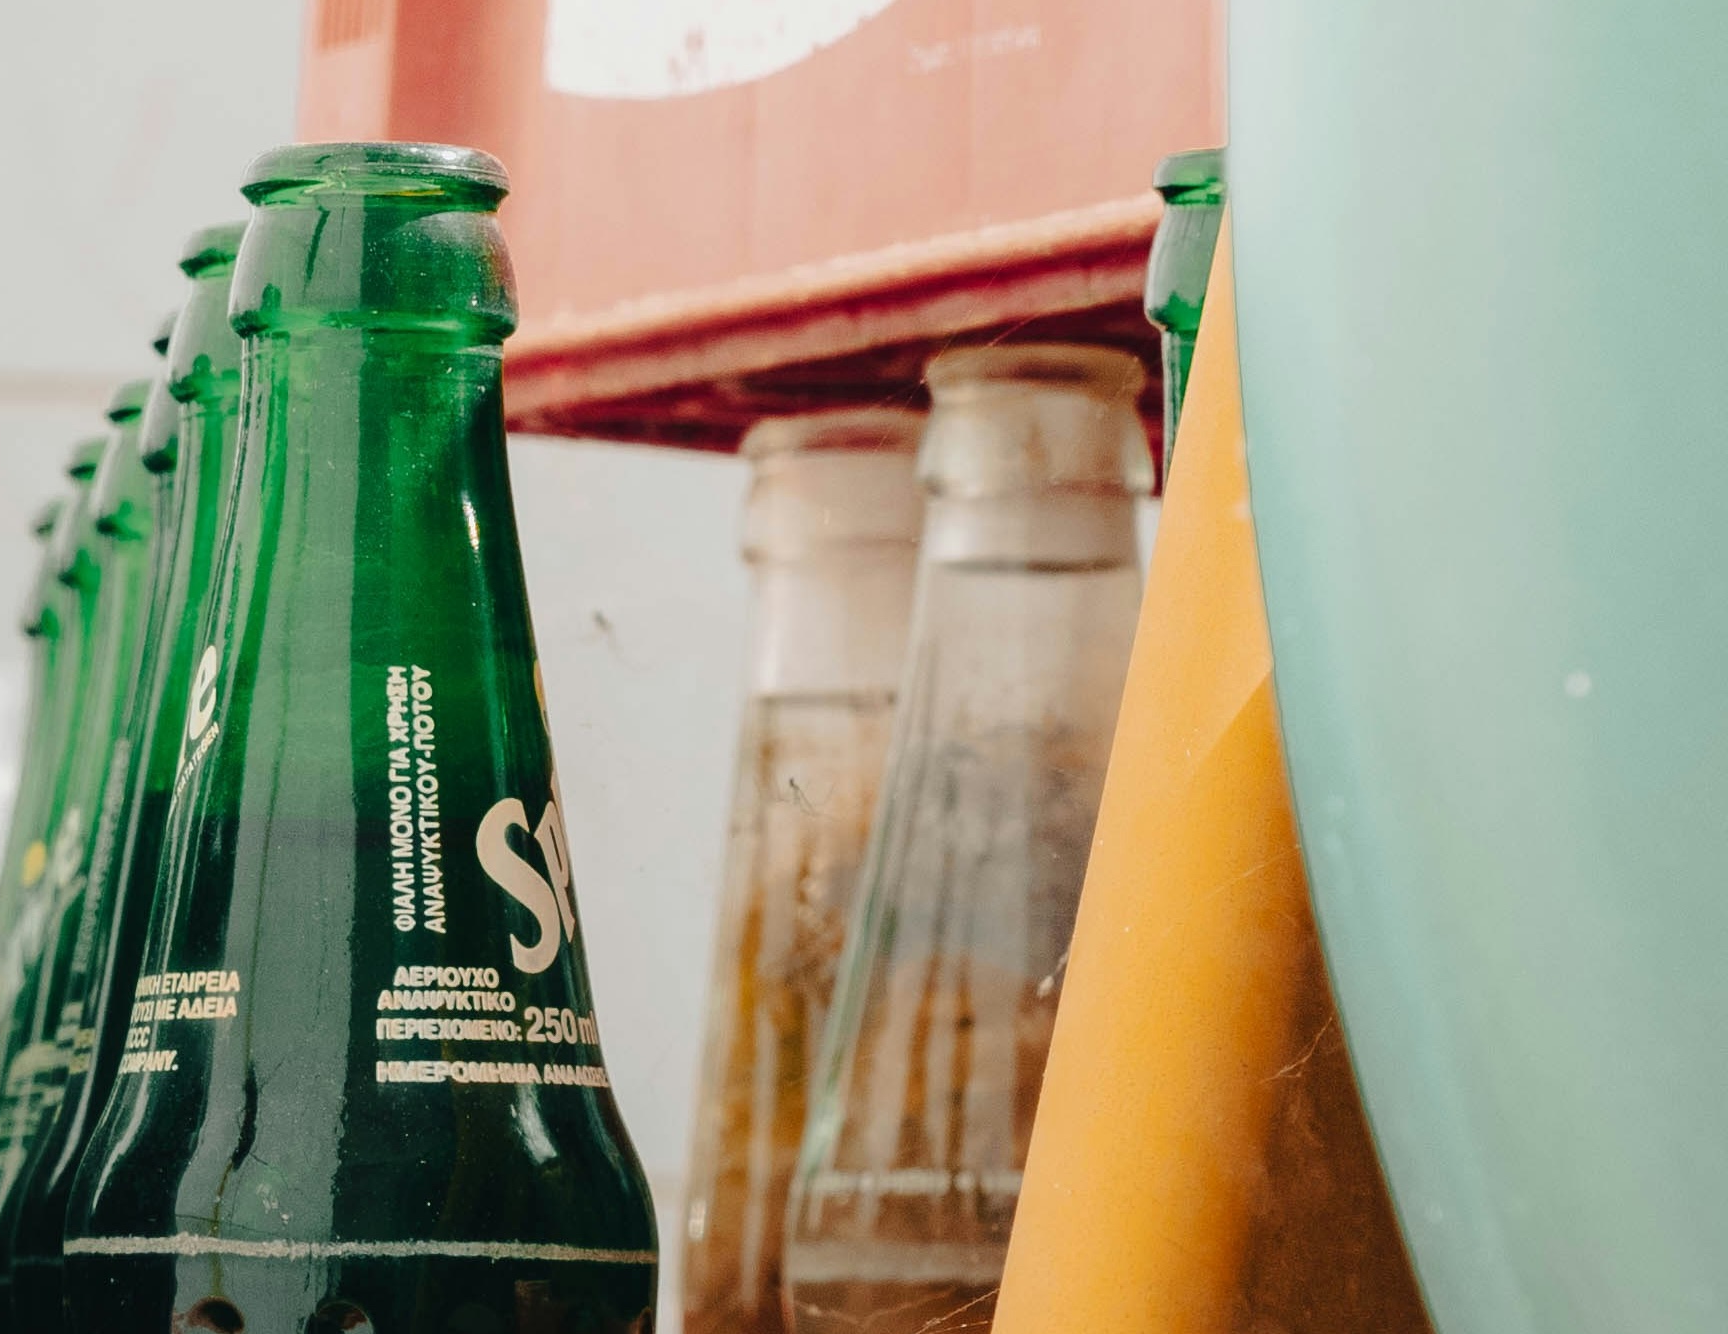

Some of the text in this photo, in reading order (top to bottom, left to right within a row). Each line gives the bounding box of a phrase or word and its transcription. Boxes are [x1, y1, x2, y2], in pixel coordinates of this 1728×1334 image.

[388, 747, 411, 782] ΓΙΑ
[388, 786, 414, 858] ΜΟΝΟ
[392, 862, 416, 932] ΦΙΑΛΗ
[161, 971, 240, 994] ΕΤΑΙΡΕΙΑ
[393, 966, 500, 989] ΑΕΡΙΟΥΧΟ
[177, 996, 238, 1019] ΑΔΕΙΑ
[377, 990, 516, 1012] ΑΝΑΨΥΚΤΙΚΟ
[524, 1006, 578, 1044] 250
[376, 1060, 543, 1084] ΗΜΕΡΟΜΗΝΙΑ
